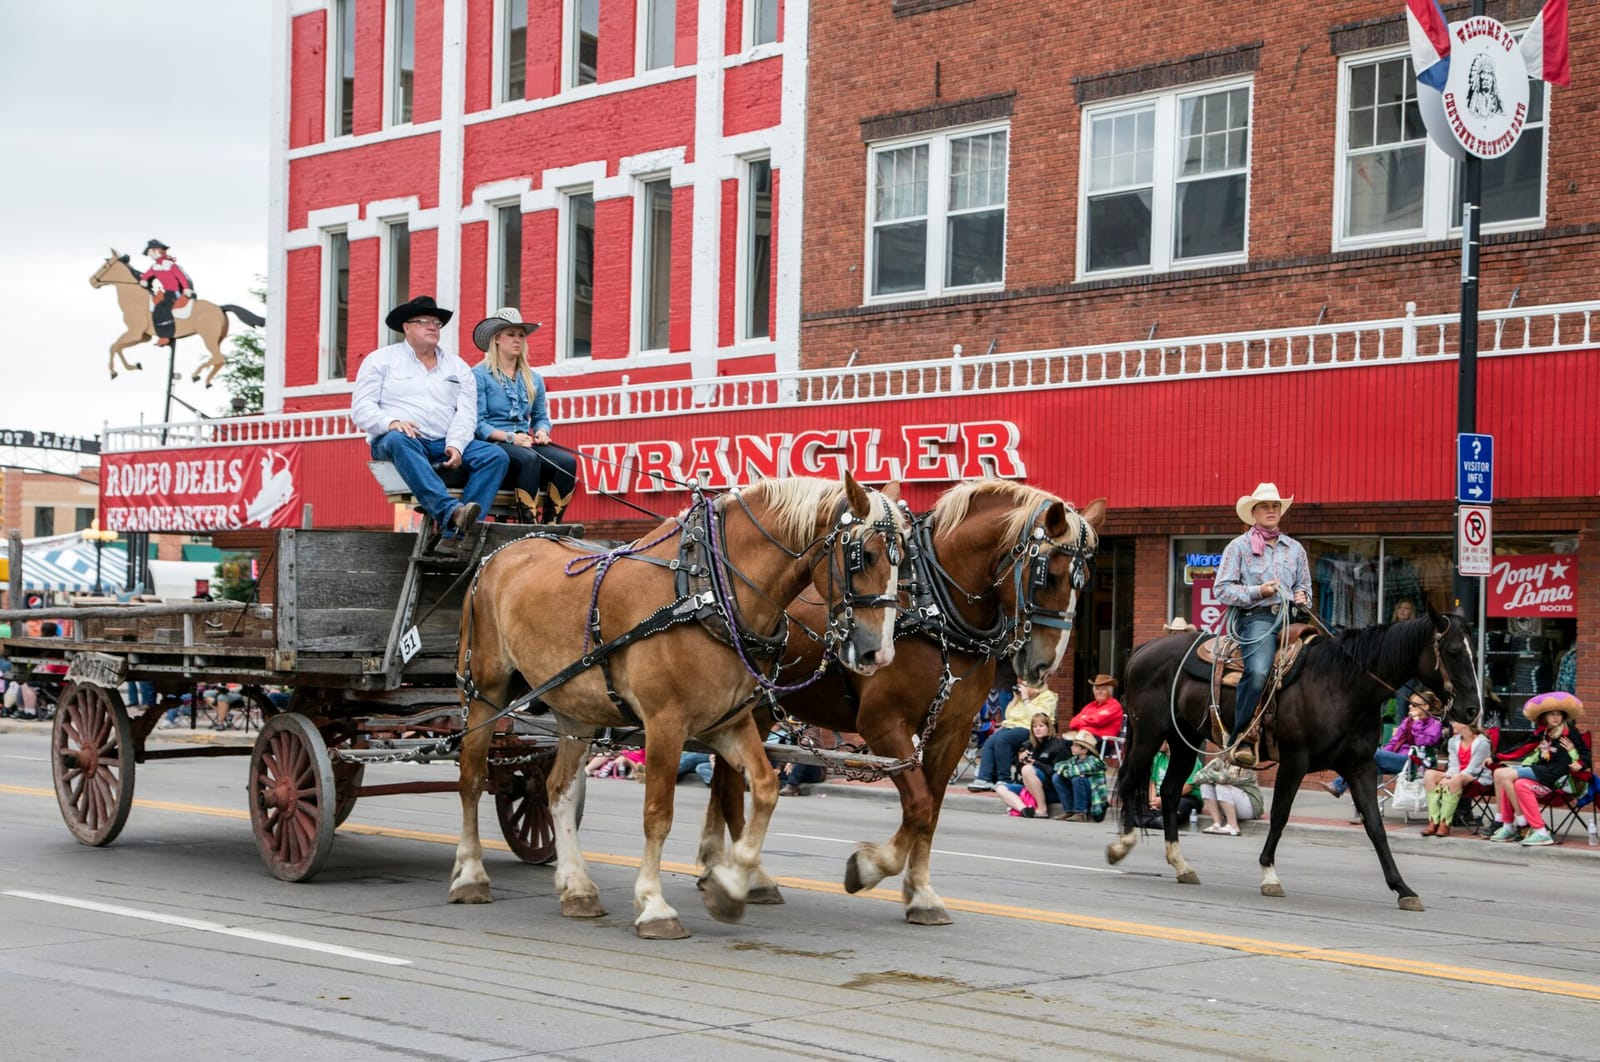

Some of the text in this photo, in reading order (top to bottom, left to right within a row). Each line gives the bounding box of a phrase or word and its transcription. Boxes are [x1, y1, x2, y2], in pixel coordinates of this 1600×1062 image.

[1456, 19, 1514, 52] WELCOME TO
[1510, 101, 1527, 134] DAYS
[0, 430, 82, 451] OT PLAZA
[578, 420, 1027, 494] WRANGLER
[1463, 461, 1490, 473] VISITOR
[105, 458, 244, 497] RODEO DEALS
[106, 504, 242, 532] HEADQUARTERS
[1493, 562, 1545, 594] Tony
[1503, 582, 1573, 610] Lama
[1540, 604, 1573, 612] BOOTS
[404, 634, 416, 655] 51
